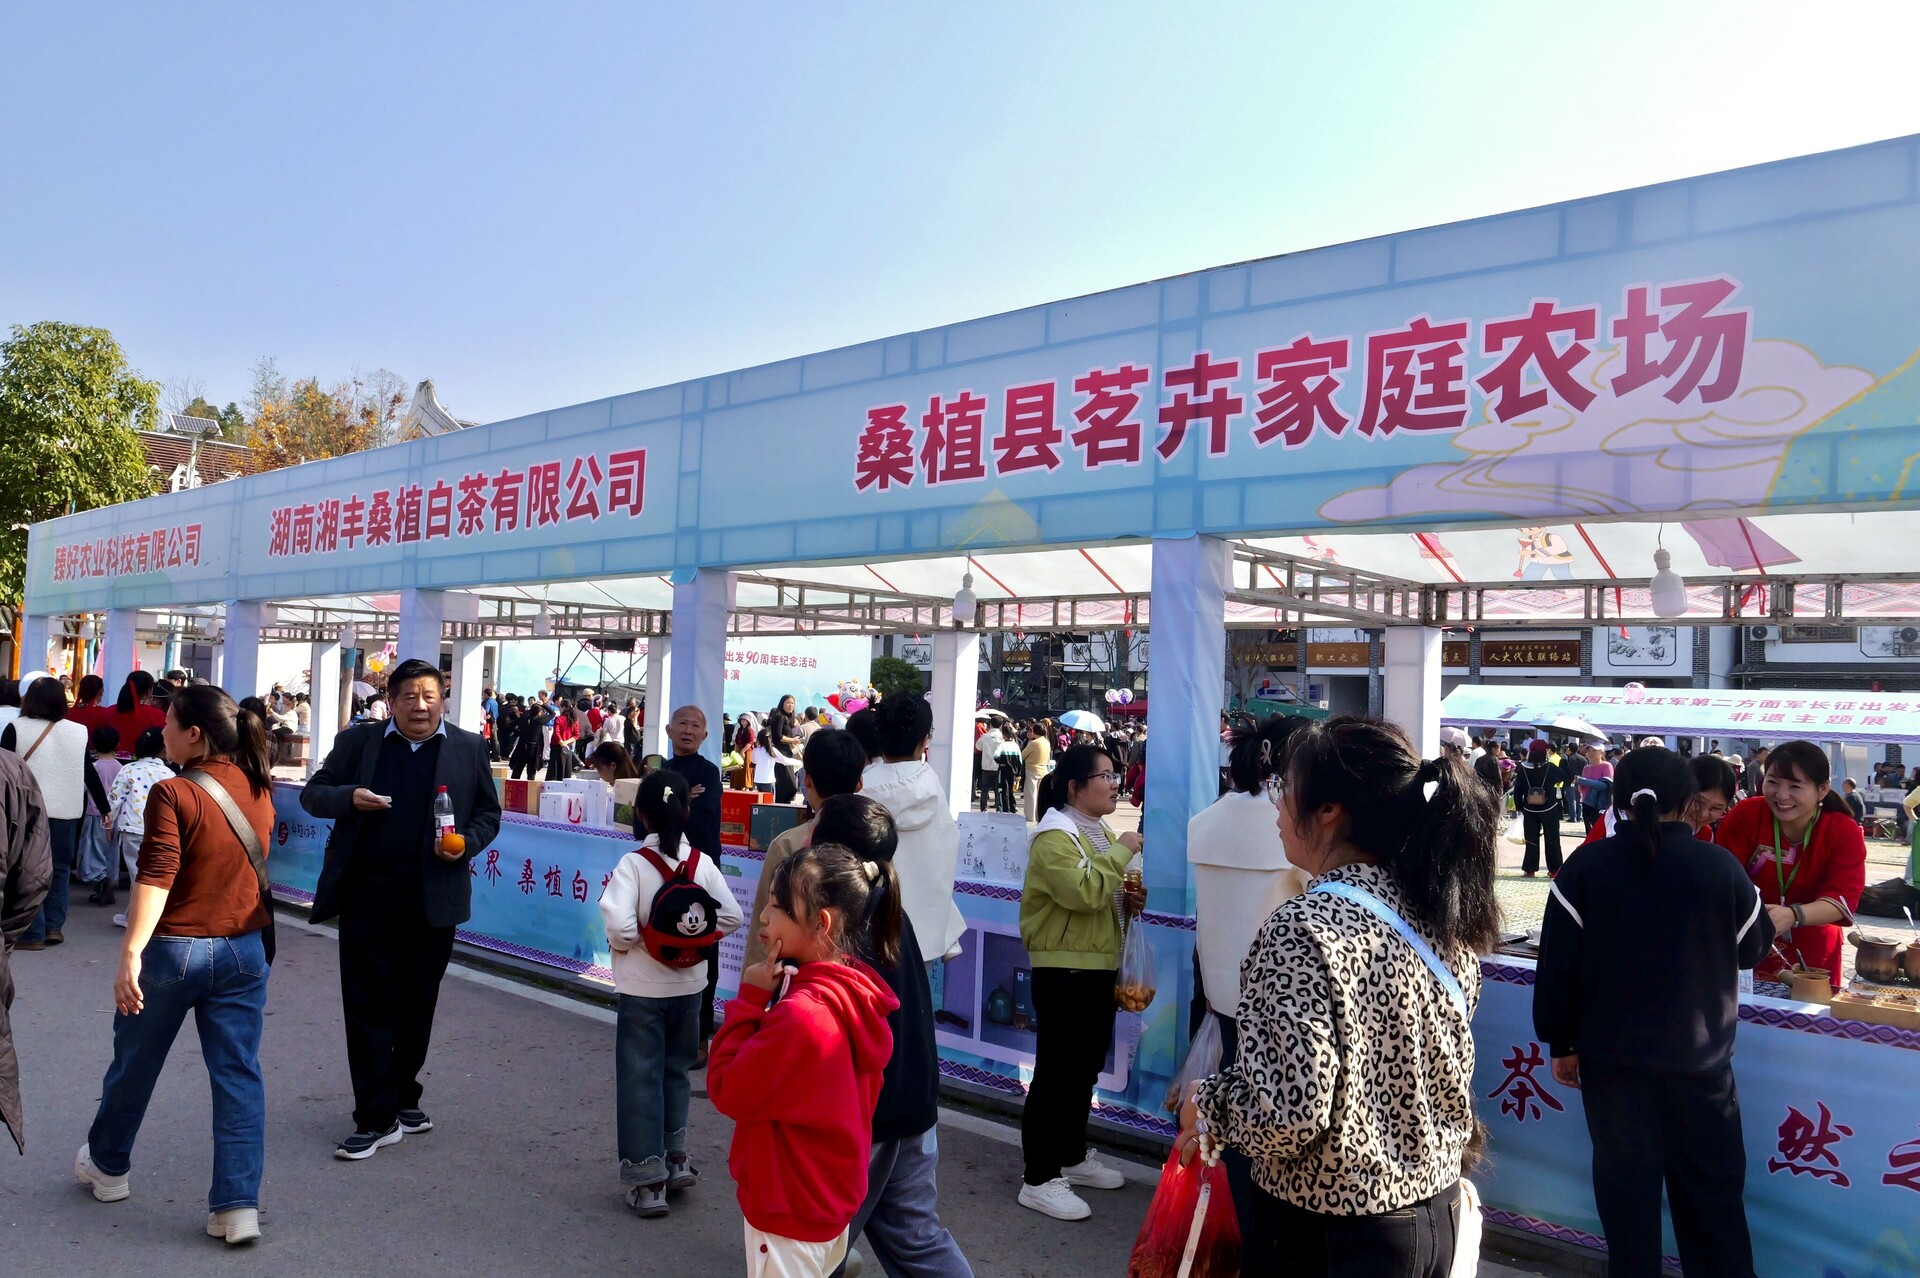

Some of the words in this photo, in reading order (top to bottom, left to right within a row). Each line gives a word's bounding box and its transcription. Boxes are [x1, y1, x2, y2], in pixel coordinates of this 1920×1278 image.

[854, 278, 1748, 490] 桑植县茗卉家庭农场
[268, 448, 647, 557] 湖南湘丰桑植白茶有限公司
[53, 524, 202, 582] 臻好农业科技有限公司
[724, 650, 818, 668] 出发90周年纪念活动
[1488, 651, 1572, 663] 人大代表联络站
[1562, 695, 1920, 713] 中国工红军第二方面军长征出发
[1727, 712, 1889, 726] 非遗主题展
[1487, 1041, 1566, 1124] 茶
